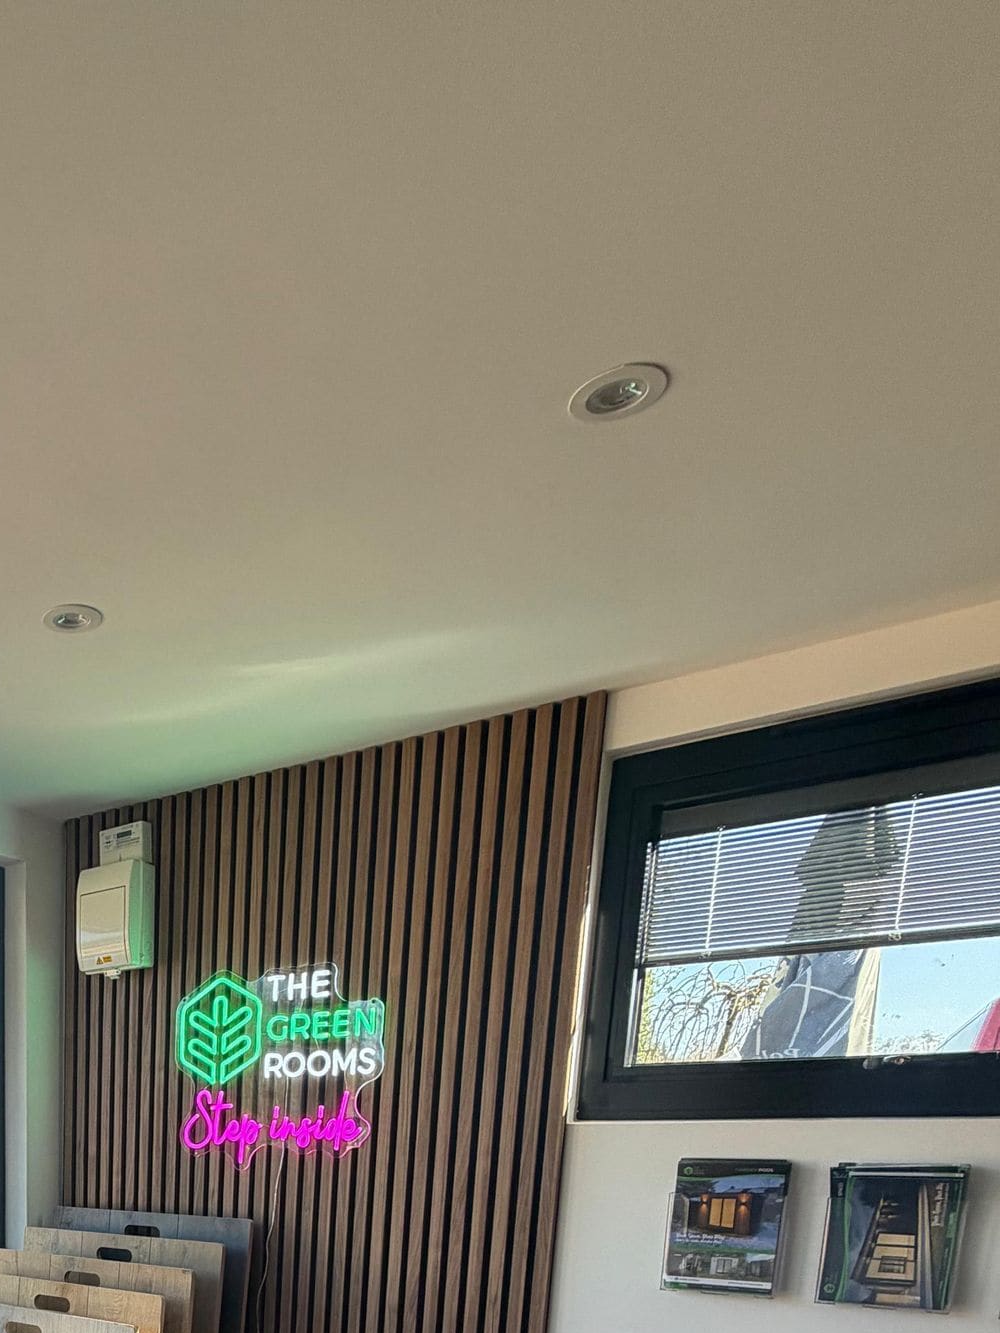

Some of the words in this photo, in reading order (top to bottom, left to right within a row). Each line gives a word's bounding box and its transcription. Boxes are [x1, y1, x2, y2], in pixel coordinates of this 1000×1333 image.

[266, 969, 331, 1002] THE
[265, 1006, 377, 1042] GREEN
[263, 1046, 376, 1079] ROOMS
[184, 1089, 262, 1164] Step
[268, 1090, 362, 1152] inside
